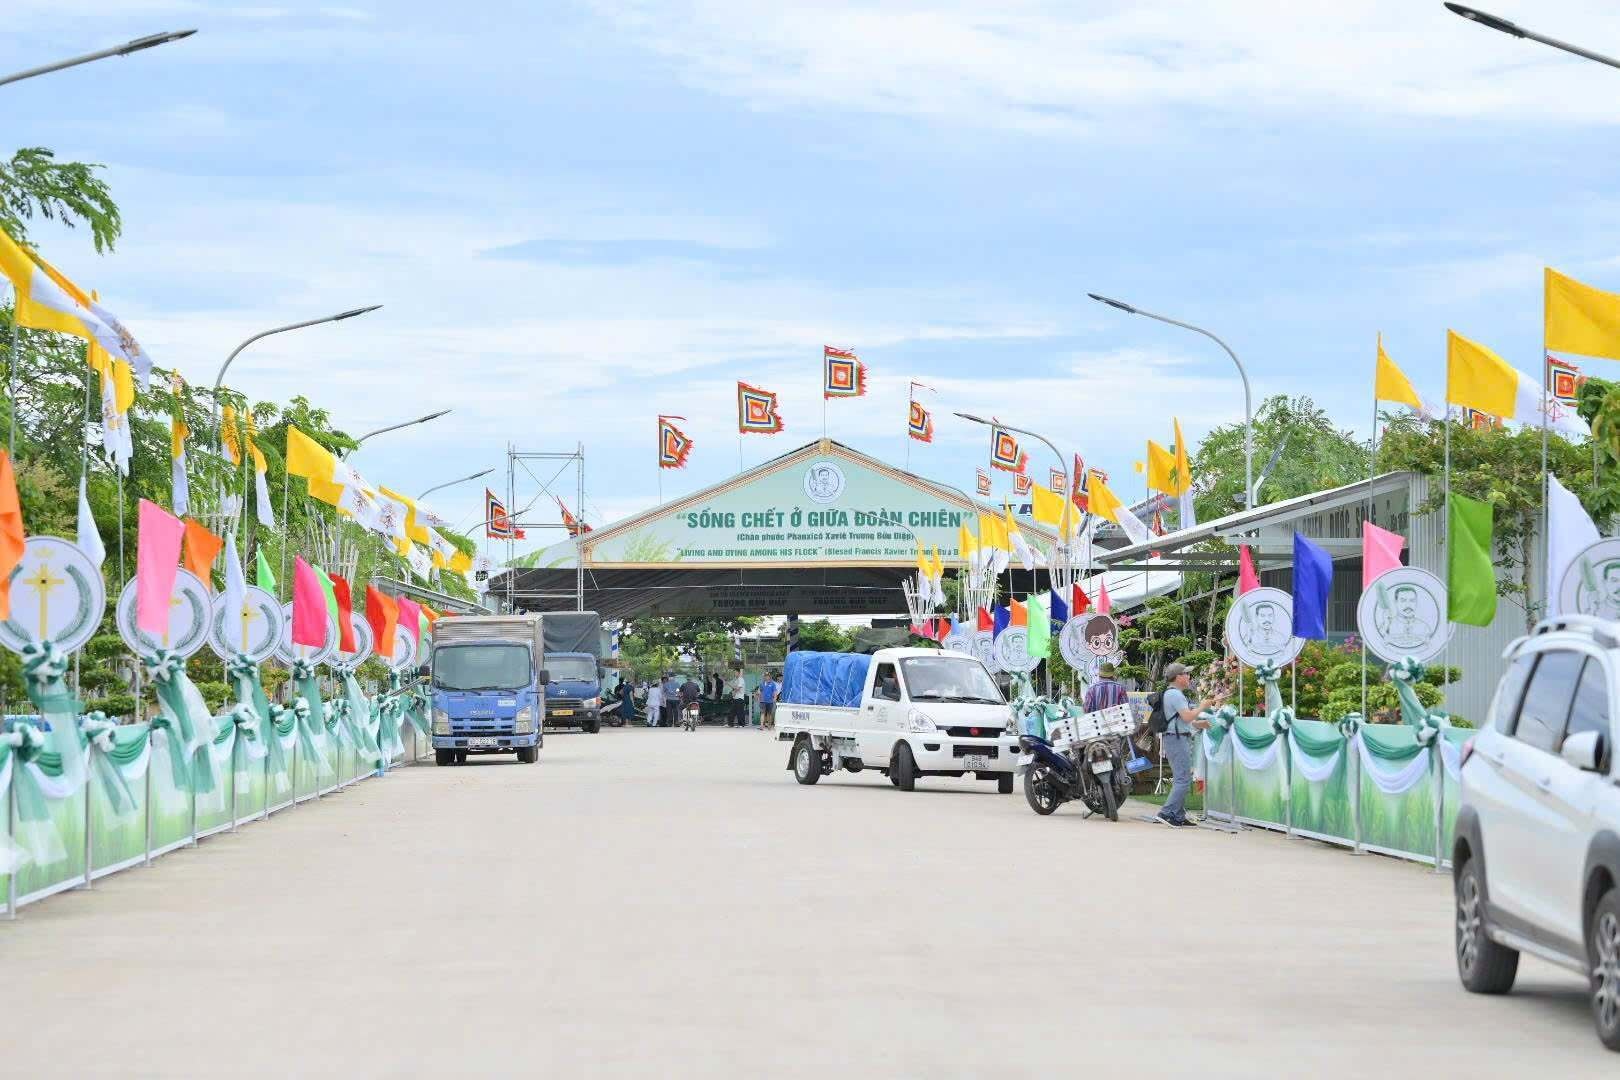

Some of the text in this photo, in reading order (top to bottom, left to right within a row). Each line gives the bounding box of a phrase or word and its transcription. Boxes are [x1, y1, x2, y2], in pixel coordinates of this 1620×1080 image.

[741, 506, 785, 528] CHẾT
[790, 506, 803, 528] Ở
[807, 507, 849, 528] GIỮA
[853, 507, 903, 528] ĐOÀN
[707, 549, 723, 557] AND
[749, 548, 778, 557] AMONG
[779, 548, 794, 557] HIS
[854, 547, 882, 556] Francis
[884, 547, 908, 556] Xavier
